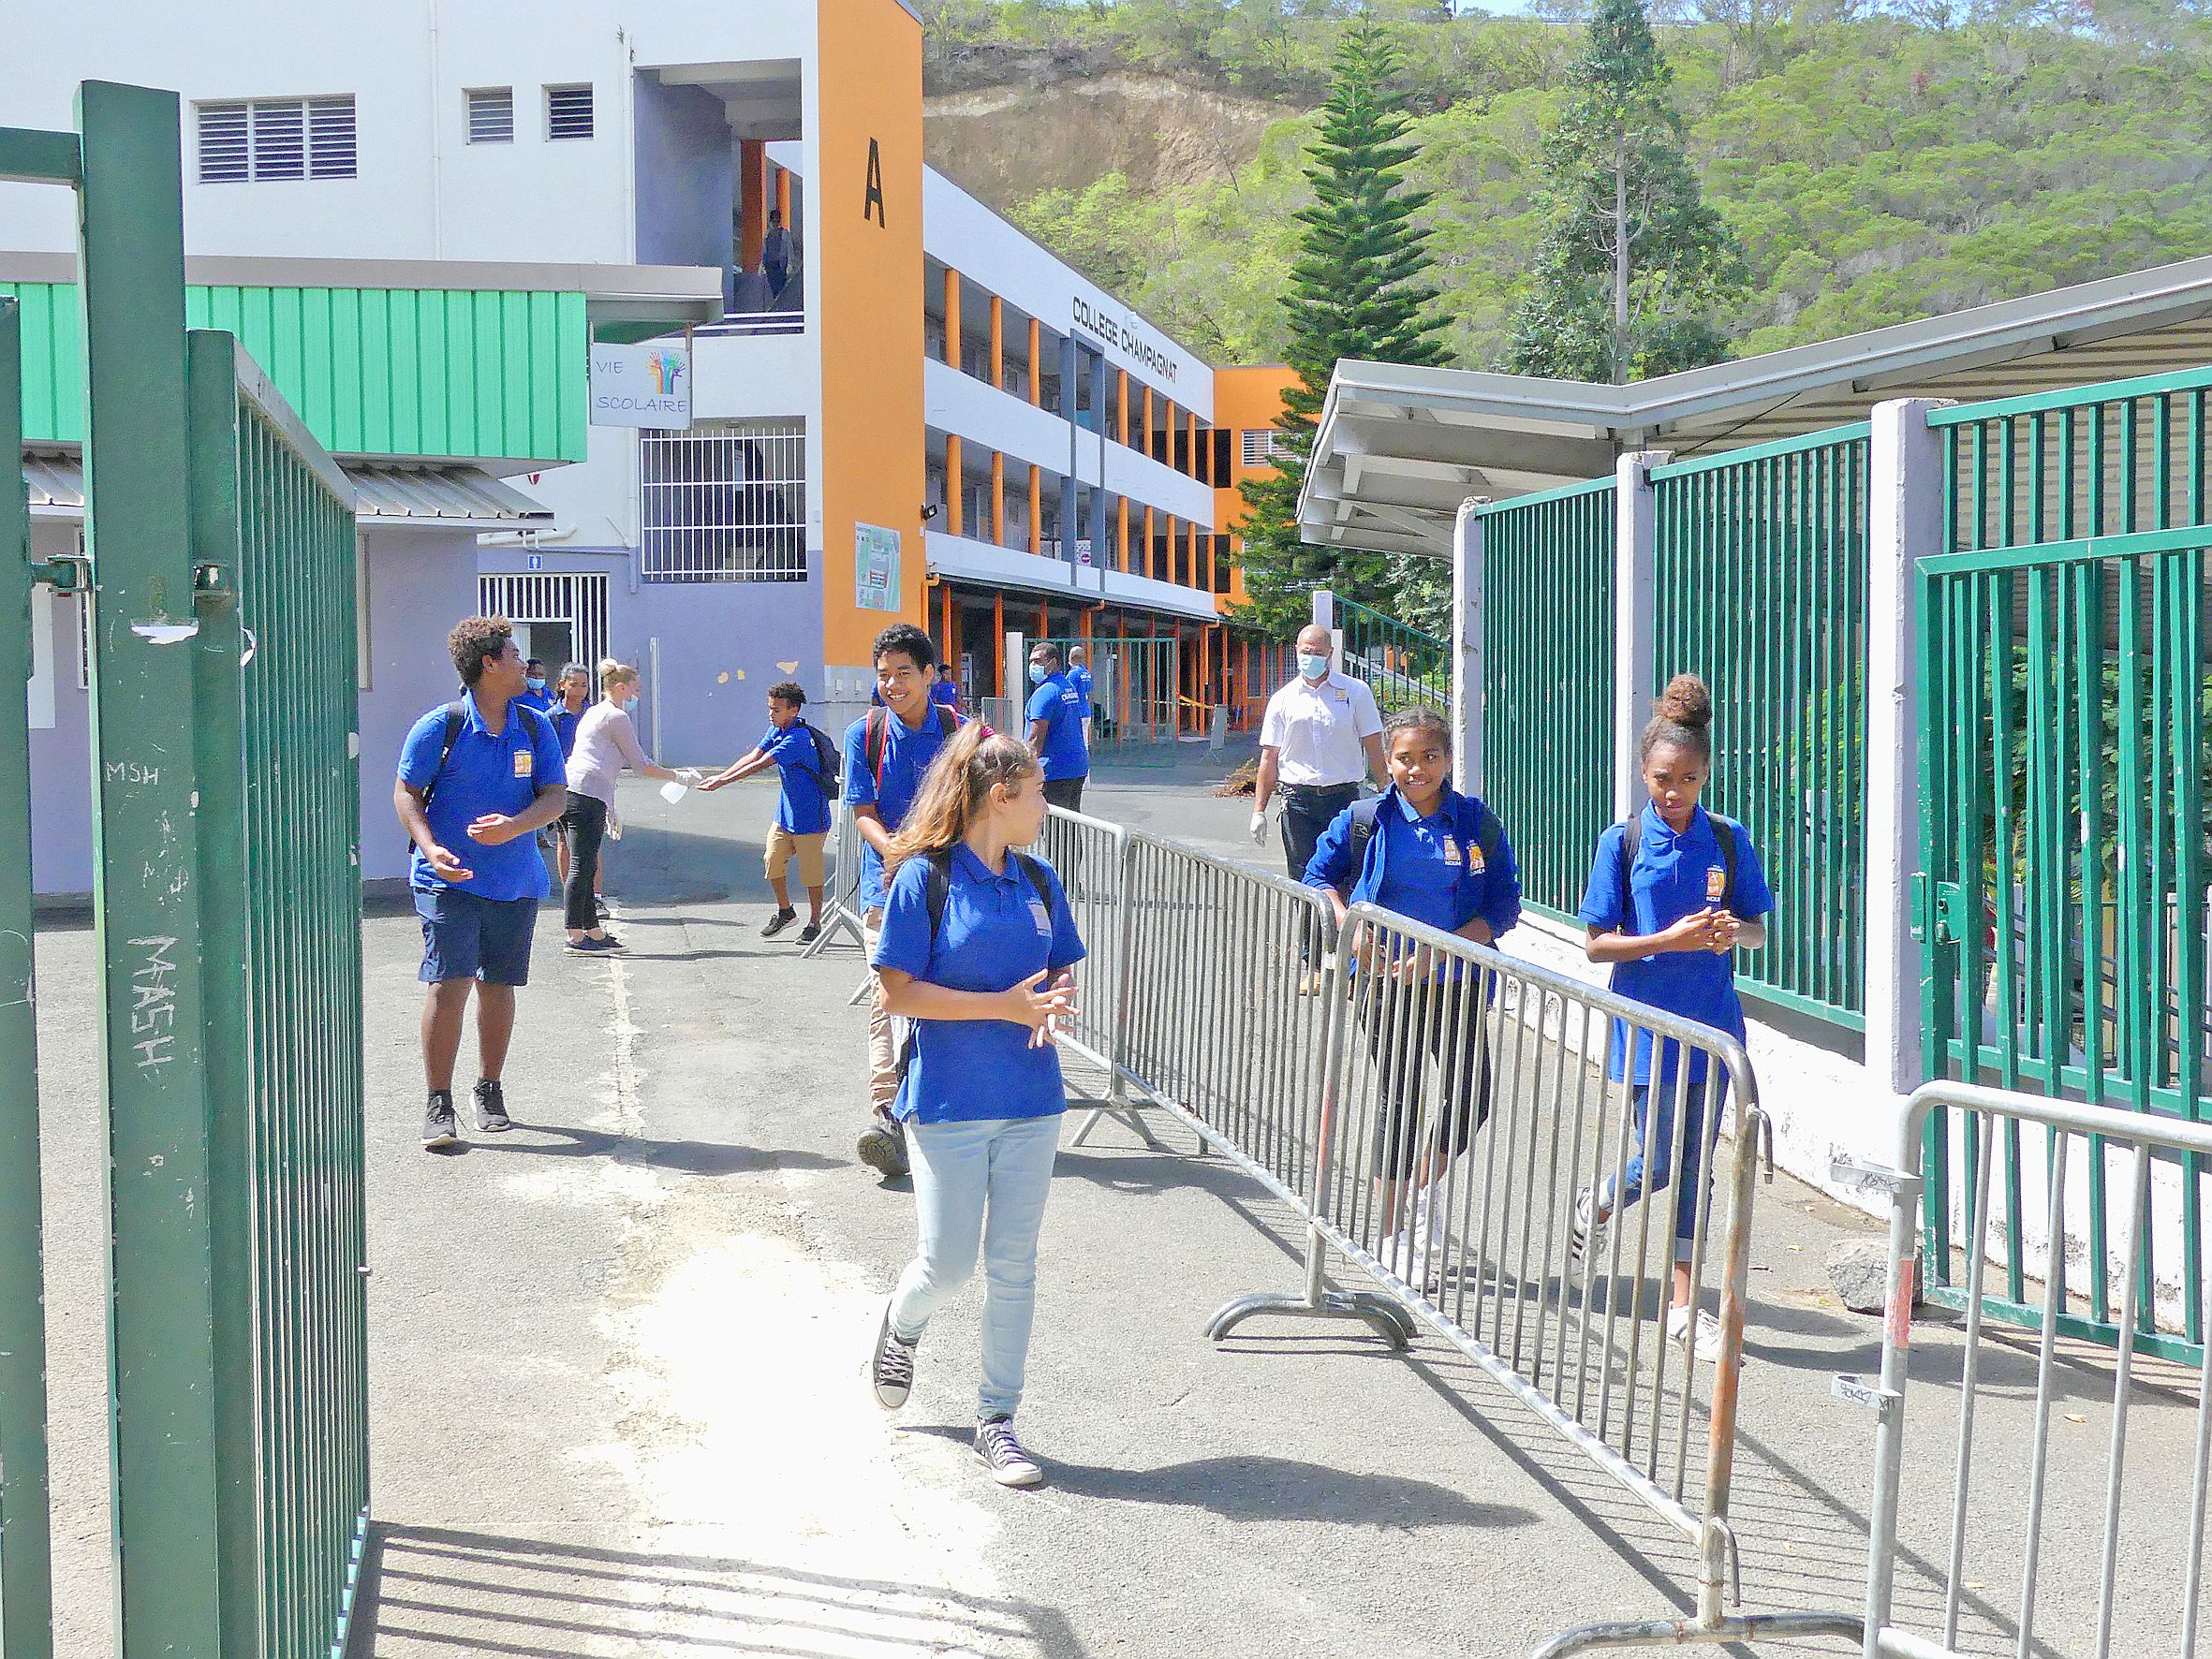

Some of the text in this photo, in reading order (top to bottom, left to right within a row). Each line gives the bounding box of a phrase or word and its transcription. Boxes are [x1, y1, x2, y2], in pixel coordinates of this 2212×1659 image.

[863, 136, 885, 230] A
[596, 360, 624, 374] VIE
[1072, 296, 1178, 384] COLLEGE CHAMPAGNAT
[596, 396, 687, 413] SCOLAIRE
[105, 761, 159, 786] MSH
[126, 934, 180, 1069] MASH
